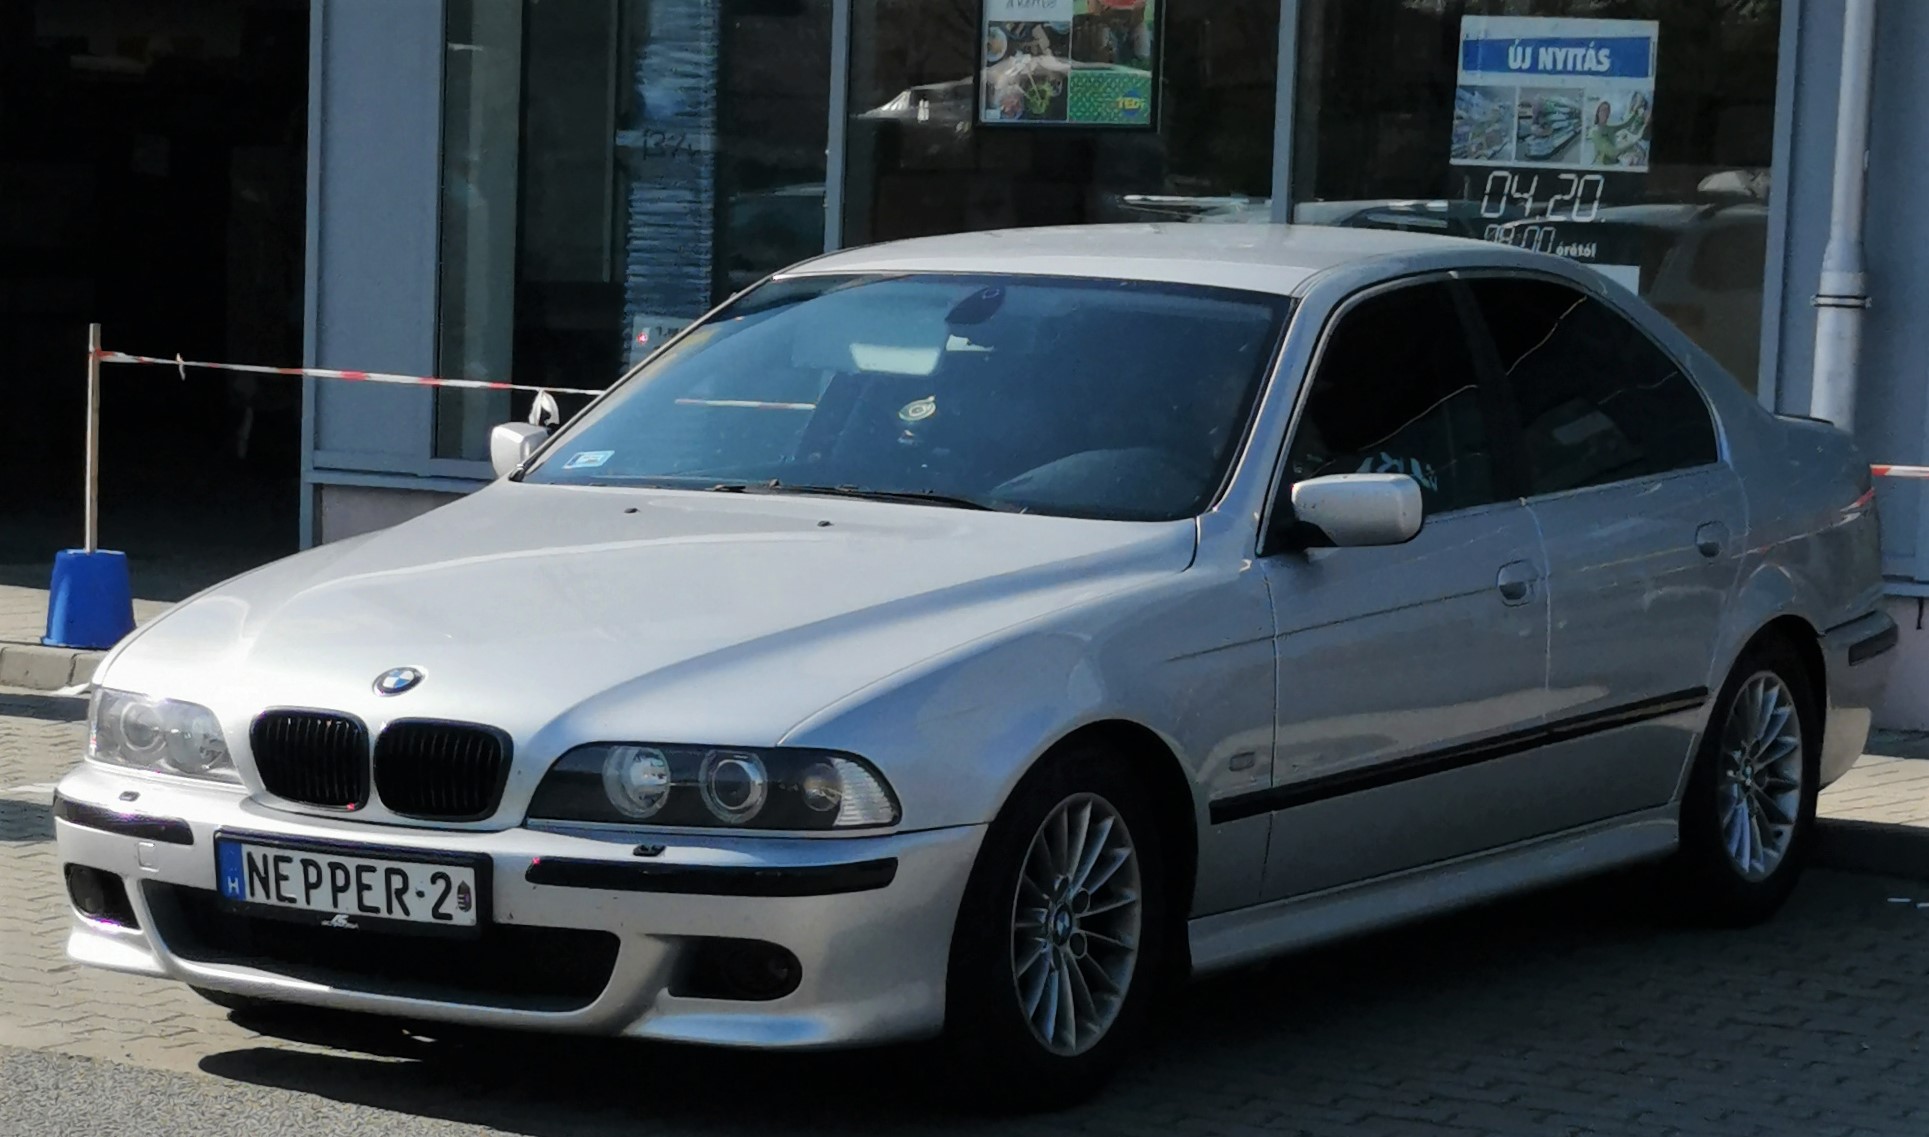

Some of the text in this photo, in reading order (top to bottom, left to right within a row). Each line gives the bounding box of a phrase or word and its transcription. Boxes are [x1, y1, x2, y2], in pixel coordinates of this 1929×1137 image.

[1508, 39, 1612, 72] ÚJ NYITÁS
[1556, 241, 1597, 258] órától
[227, 876, 239, 896] H
